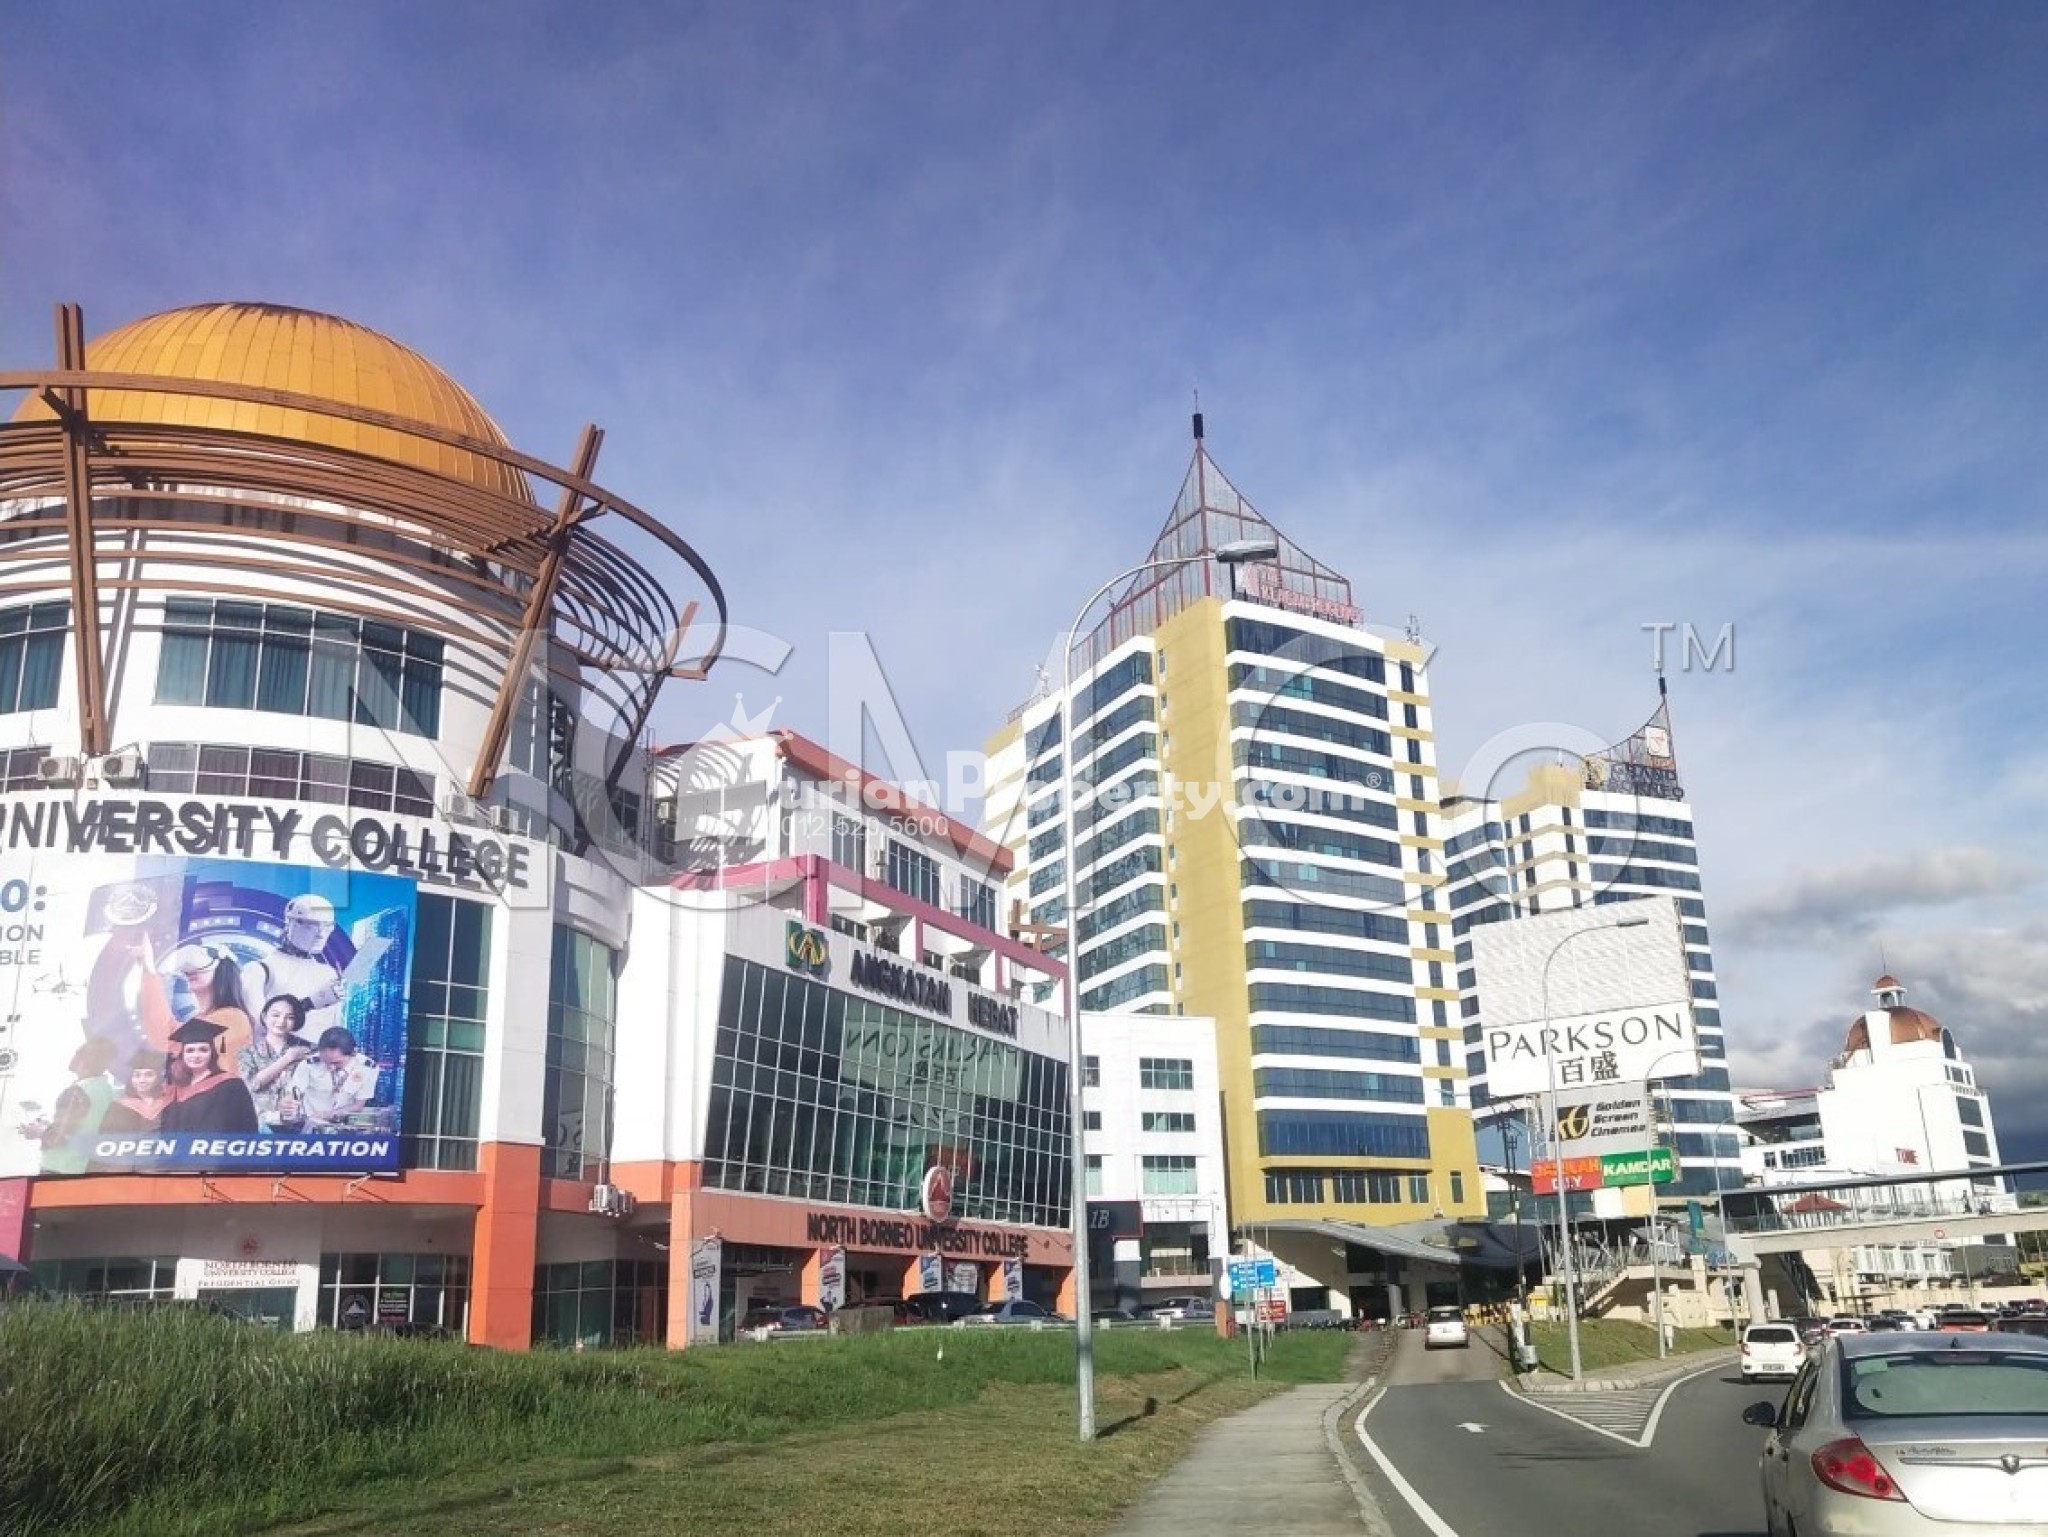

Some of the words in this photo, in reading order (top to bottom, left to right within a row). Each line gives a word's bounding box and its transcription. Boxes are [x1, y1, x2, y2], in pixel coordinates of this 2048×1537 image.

[0, 799, 302, 860] NIVERSITY
[311, 814, 529, 889] COLLEGE
[850, 949, 952, 1019] ANGKATAN
[966, 990, 1019, 1041] HEBAT
[1489, 1012, 1682, 1062] PARKSON
[1557, 1050, 1621, 1085] 百盛
[1593, 1112, 1639, 1124] Screen
[1595, 1099, 1641, 1111] Golden
[1590, 1124, 1646, 1137] Cinemas
[95, 1139, 177, 1157] OPEN
[189, 1139, 389, 1157] REGISTRATION
[1603, 1157, 1673, 1178] KAMDAR
[807, 1211, 857, 1244] NORTH
[859, 1217, 914, 1249] BORNEO
[916, 1221, 981, 1254] UNIVERSITY
[982, 1231, 1029, 1258] COLLEGE
